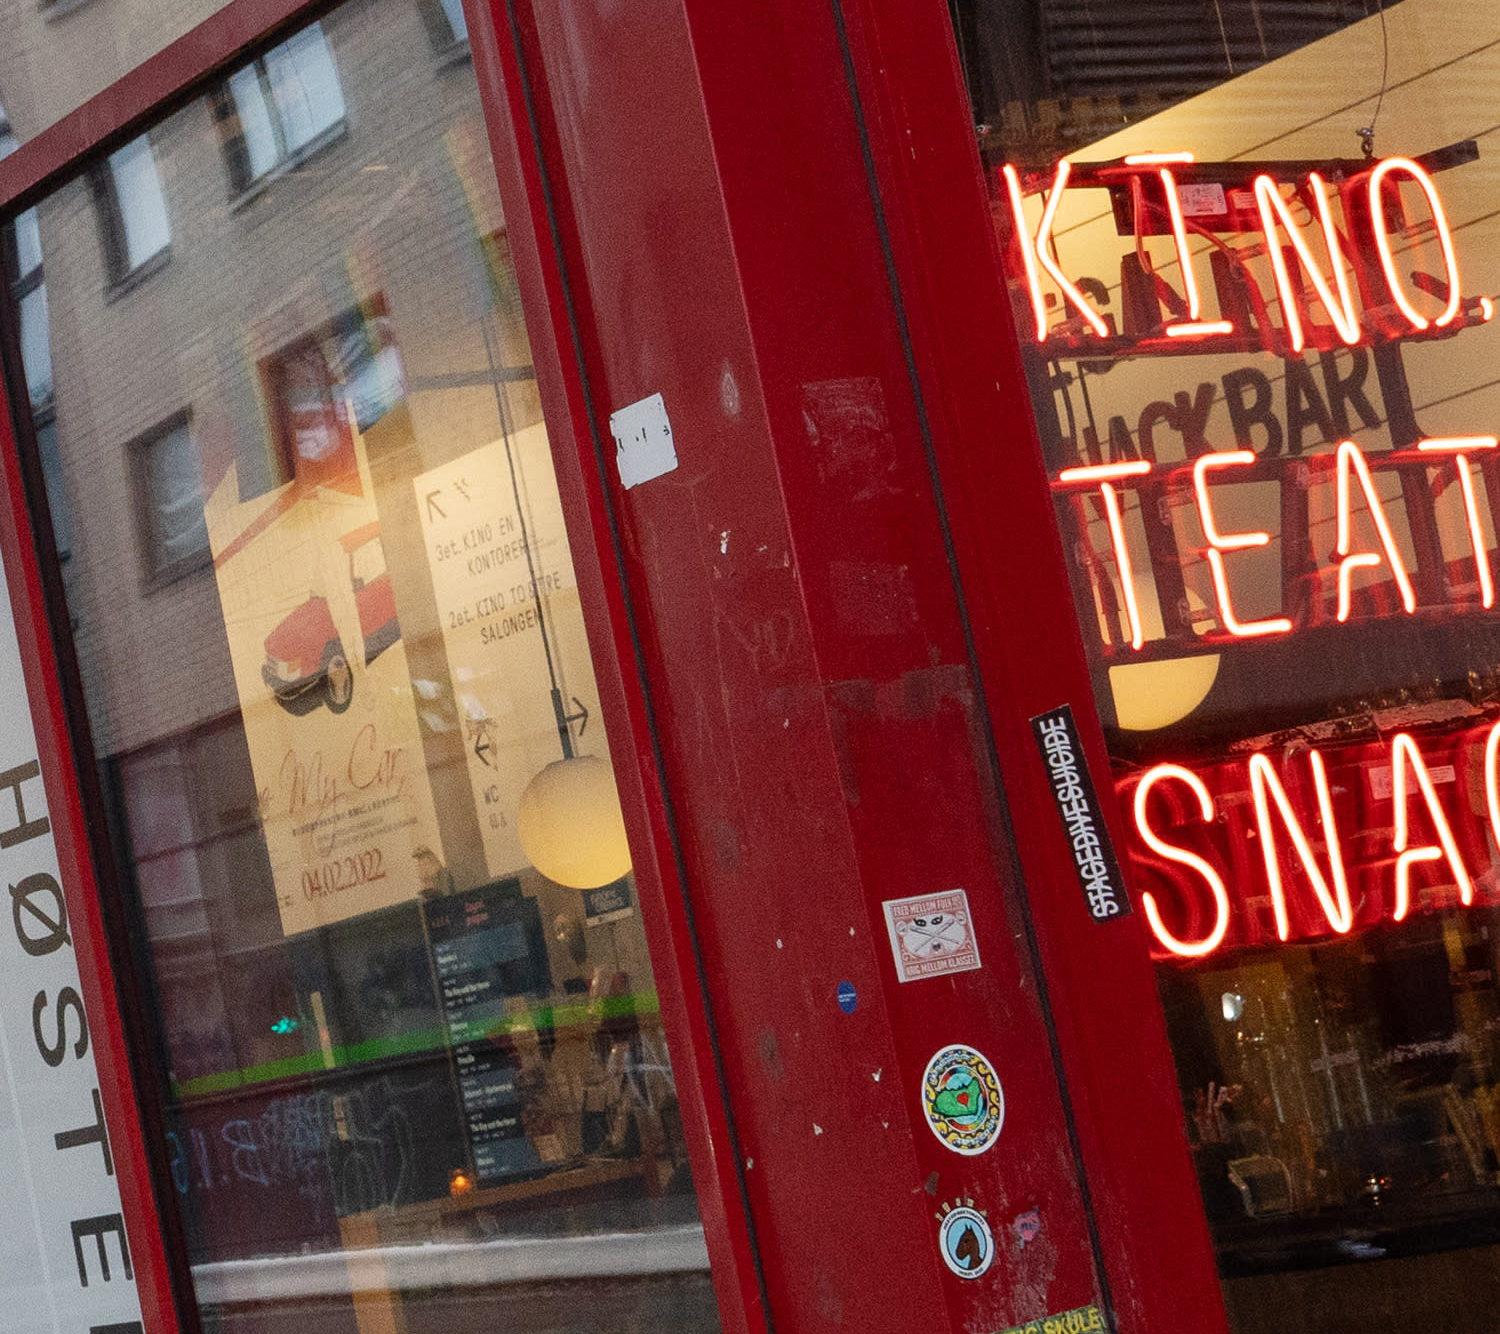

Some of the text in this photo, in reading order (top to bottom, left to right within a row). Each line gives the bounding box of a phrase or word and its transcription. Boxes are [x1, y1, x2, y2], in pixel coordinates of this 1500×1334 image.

[463, 523, 494, 553] KINO
[499, 514, 515, 536] EN
[476, 591, 507, 619] KINO
